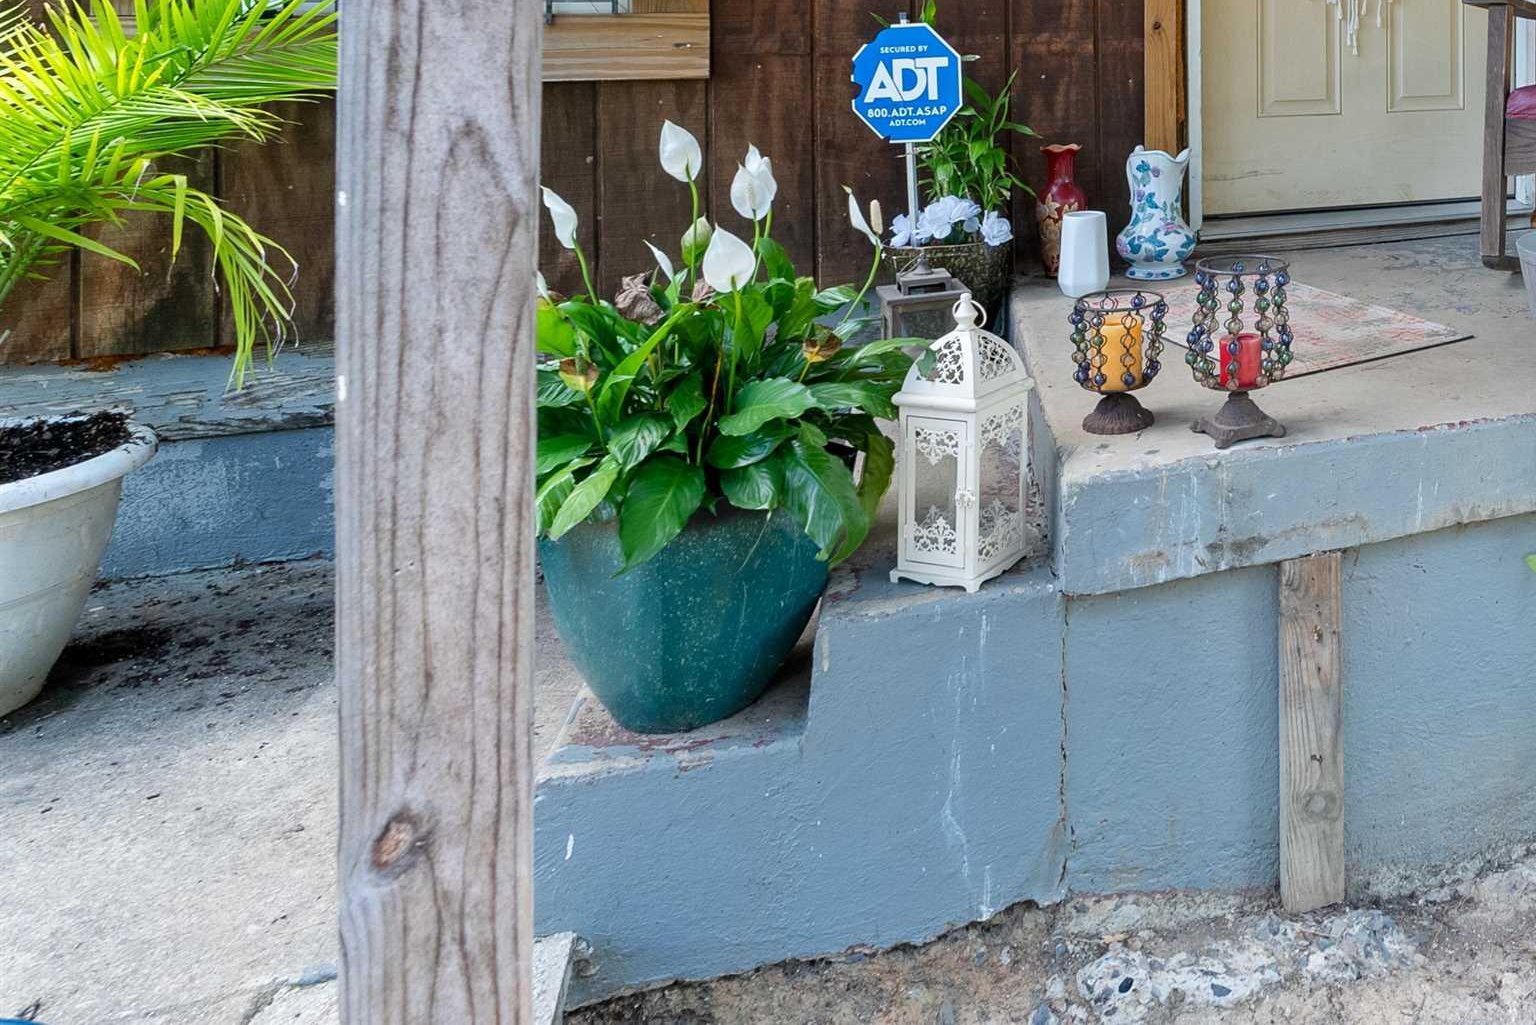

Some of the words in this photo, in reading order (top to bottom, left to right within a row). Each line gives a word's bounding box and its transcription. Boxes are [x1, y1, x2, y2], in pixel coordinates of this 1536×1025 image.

[880, 46, 917, 54] SECURED
[918, 45, 929, 53] BY
[863, 57, 949, 103] ADT
[867, 105, 947, 118] 800.ADT.ASAP
[889, 119, 927, 127] ADT.COM
